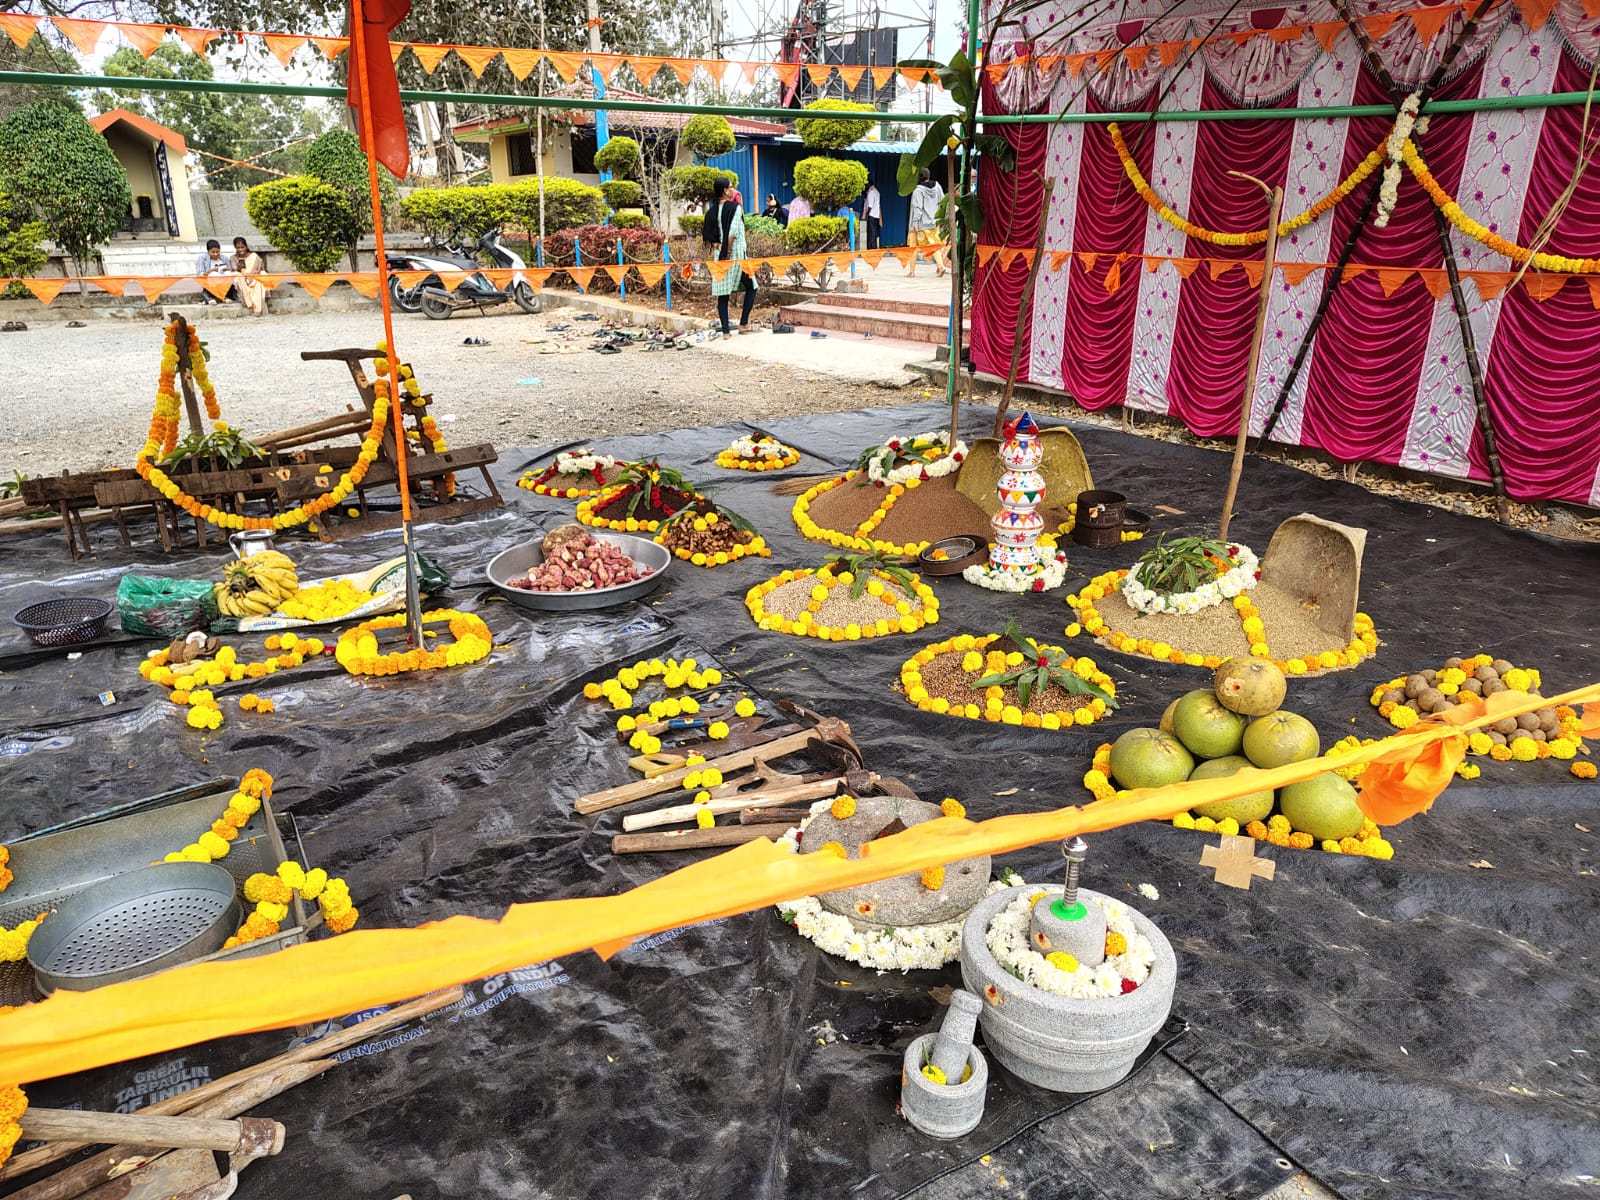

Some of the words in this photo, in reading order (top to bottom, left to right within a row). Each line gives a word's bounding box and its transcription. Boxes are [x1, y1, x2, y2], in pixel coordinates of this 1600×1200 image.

[483, 974, 507, 995] OF
[509, 961, 564, 981] INDIA
[330, 1026, 431, 1064] ERNATIONAL
[464, 973, 570, 1017] CERTIFICATIONS
[114, 1066, 209, 1105] TARPAULIN
[134, 1057, 187, 1084] GREAT
